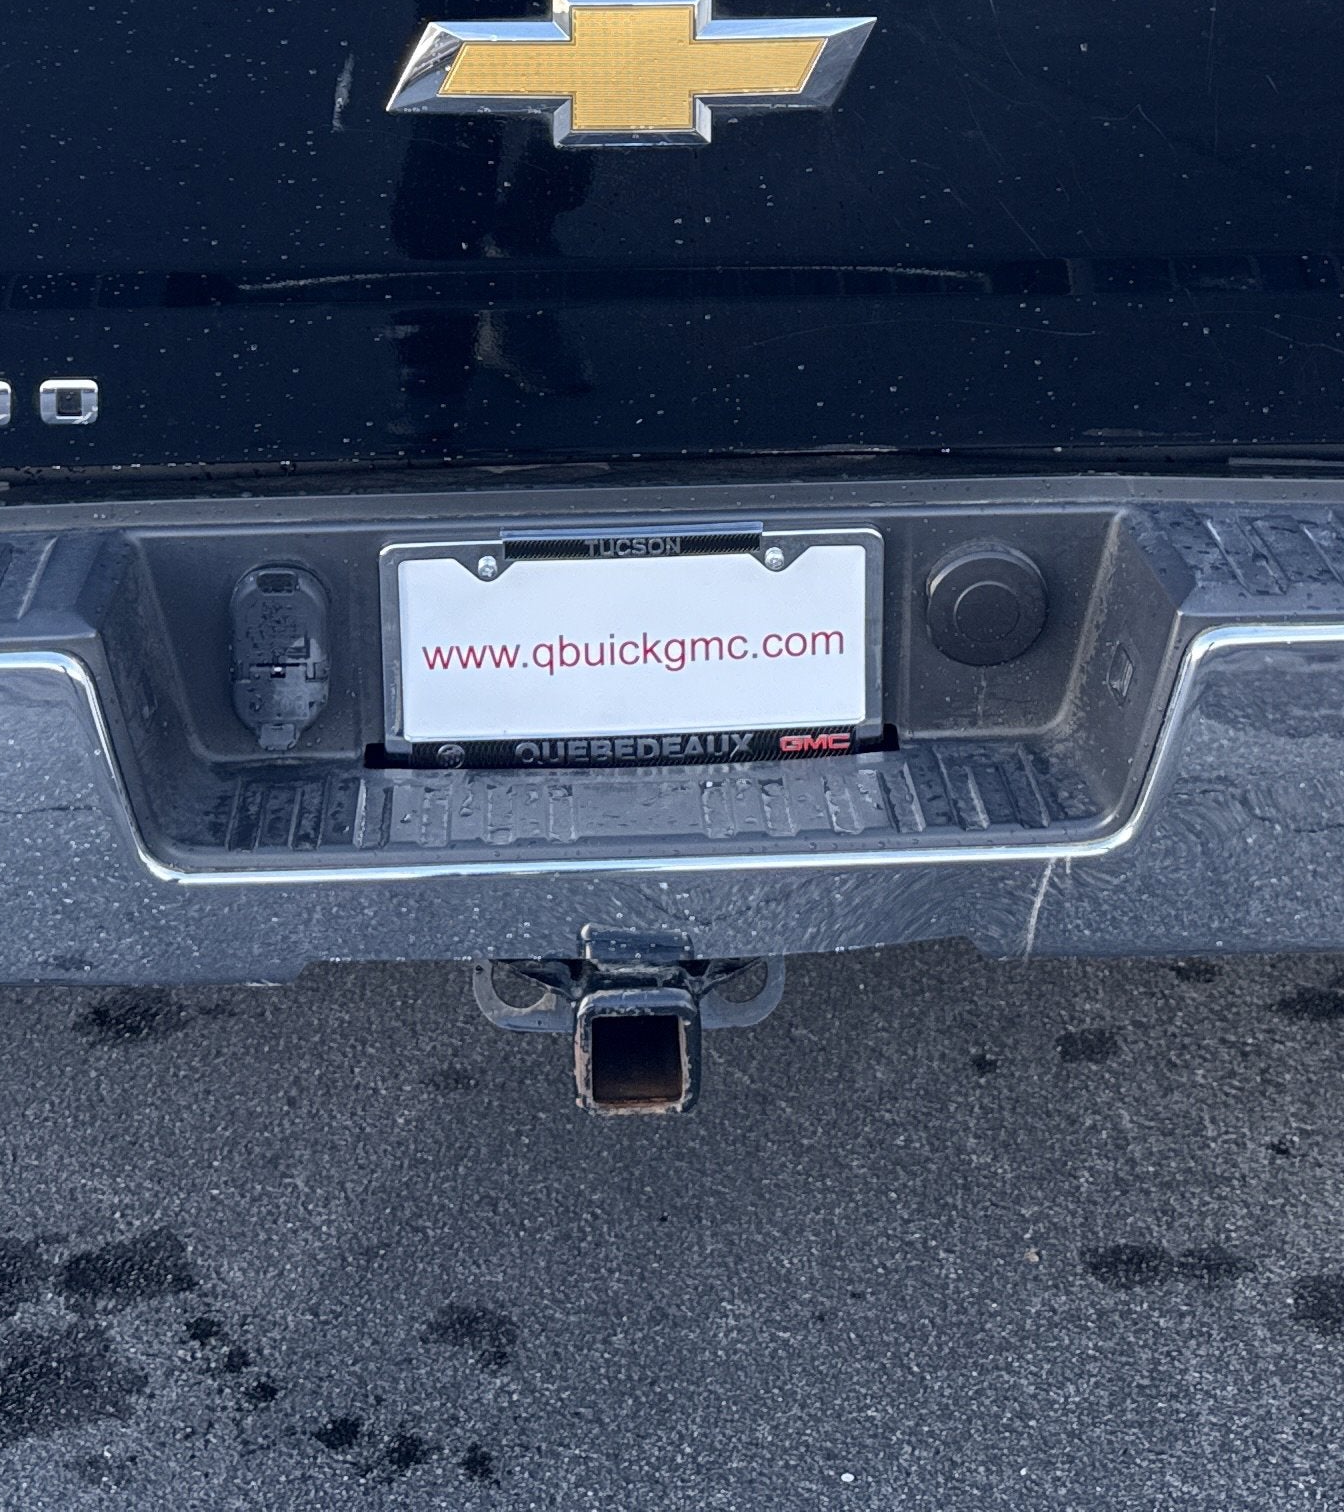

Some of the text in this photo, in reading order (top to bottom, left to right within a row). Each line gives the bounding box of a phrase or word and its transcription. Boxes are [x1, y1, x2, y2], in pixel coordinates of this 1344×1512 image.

[585, 536, 681, 558] TUCSON
[422, 629, 845, 676] www.qbuickgmc.com
[514, 731, 852, 767] QUEBEDEAUX GMC
